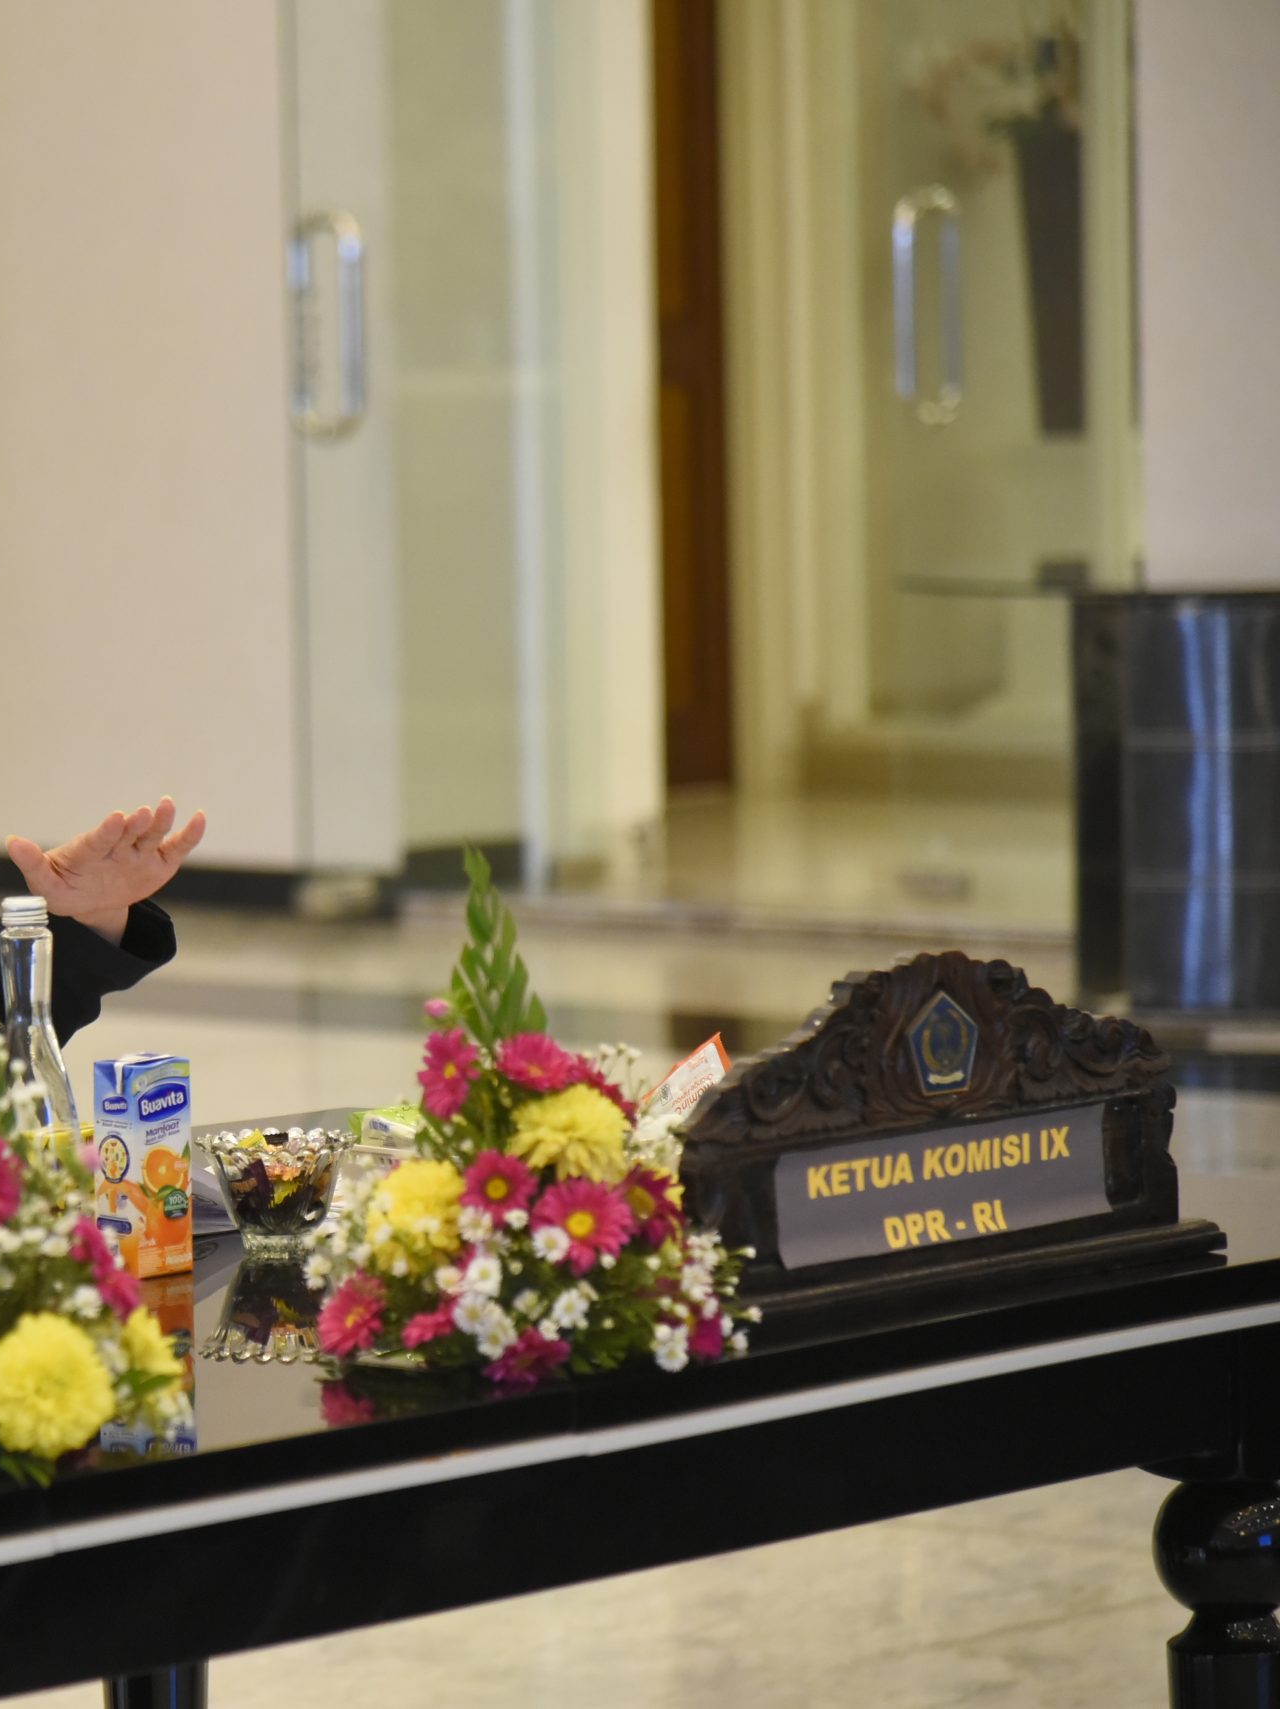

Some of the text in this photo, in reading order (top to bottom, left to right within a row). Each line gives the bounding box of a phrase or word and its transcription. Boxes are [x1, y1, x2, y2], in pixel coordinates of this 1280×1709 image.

[141, 1091, 185, 1116] Buavita
[807, 1126, 1070, 1199] KETUA KOMISI IX
[884, 1208, 950, 1249] DPR
[972, 1200, 1008, 1233] RI
